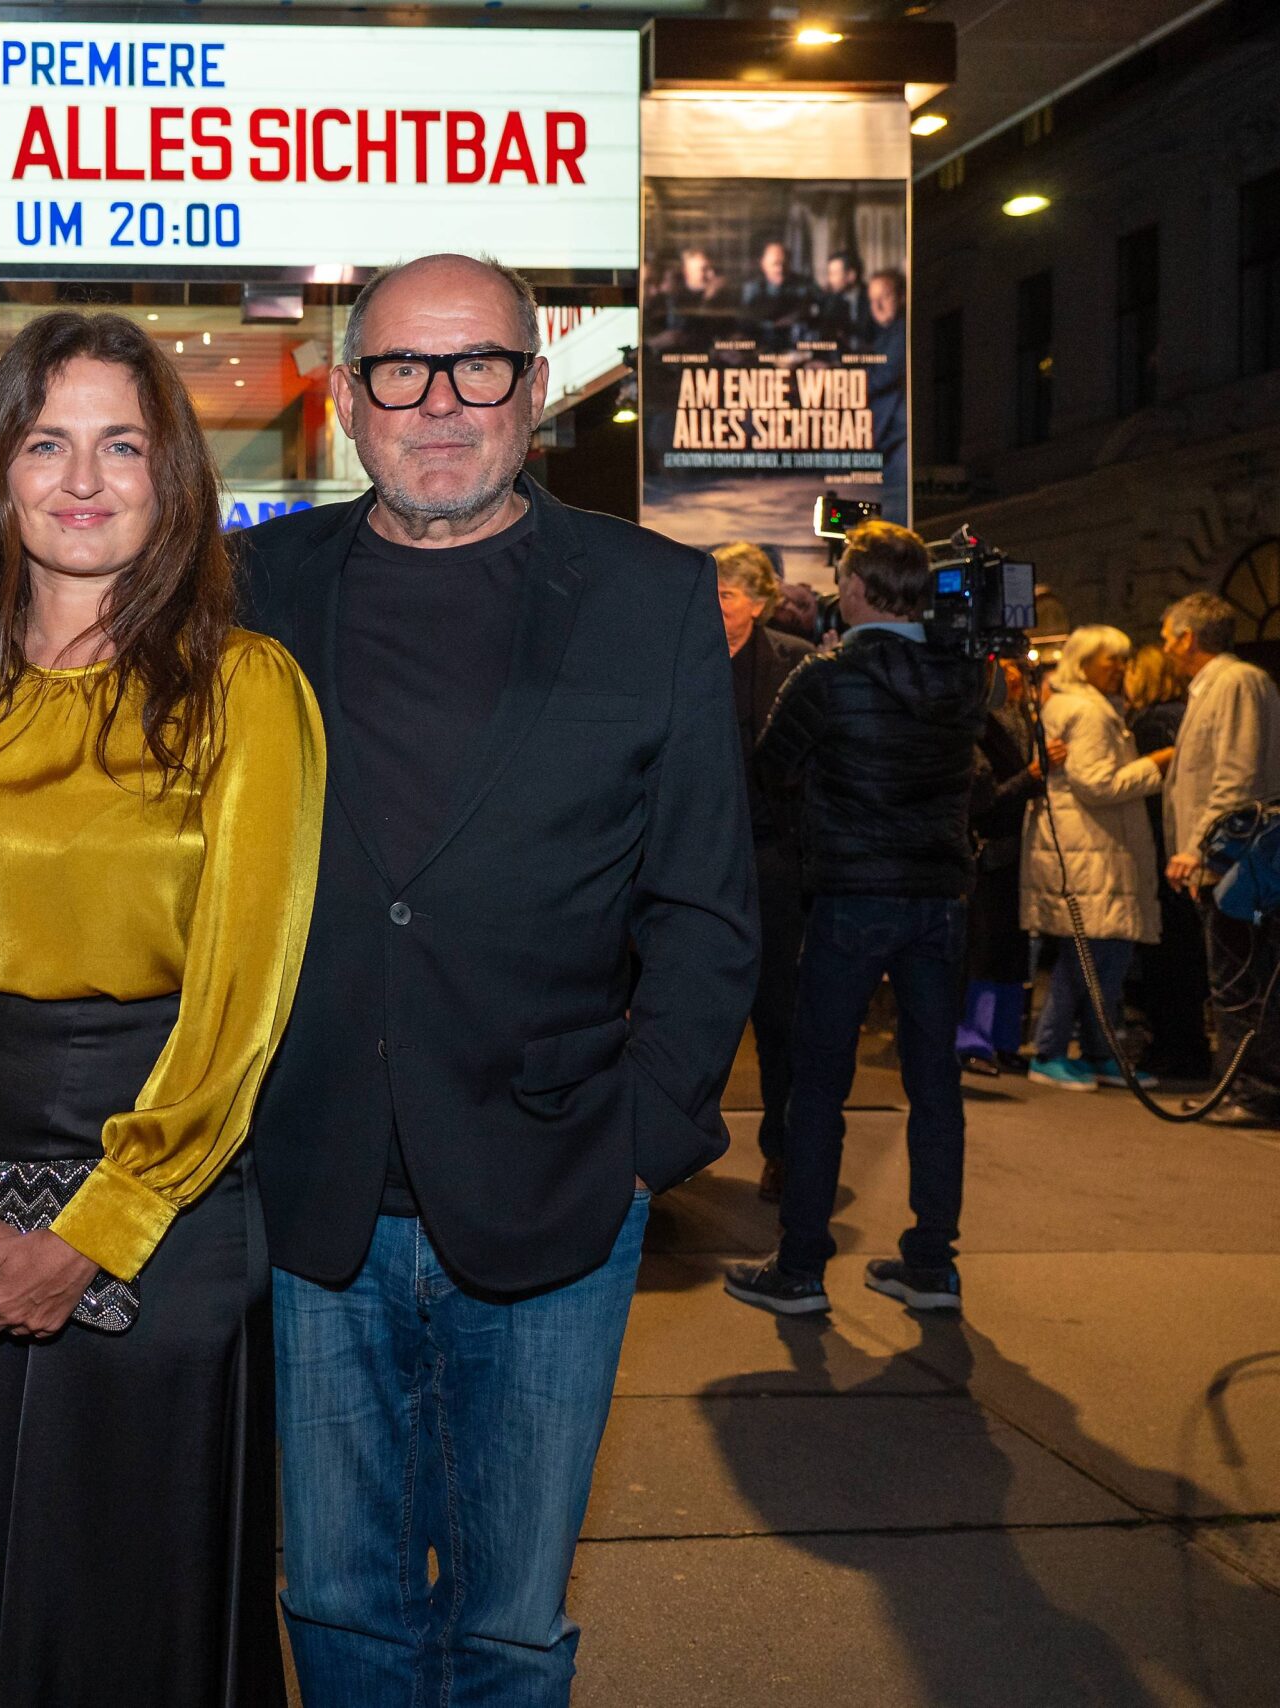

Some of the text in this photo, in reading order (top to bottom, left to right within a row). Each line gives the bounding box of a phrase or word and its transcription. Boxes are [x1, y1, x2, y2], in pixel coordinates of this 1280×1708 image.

[11, 105, 232, 181] ALLES
[249, 108, 587, 184] SICHTBAR
[17, 201, 82, 246] UM
[110, 203, 241, 247] 20:00
[678, 369, 867, 409] AM ENDE WIRD
[673, 409, 873, 450] ALLES SICHTBAR
